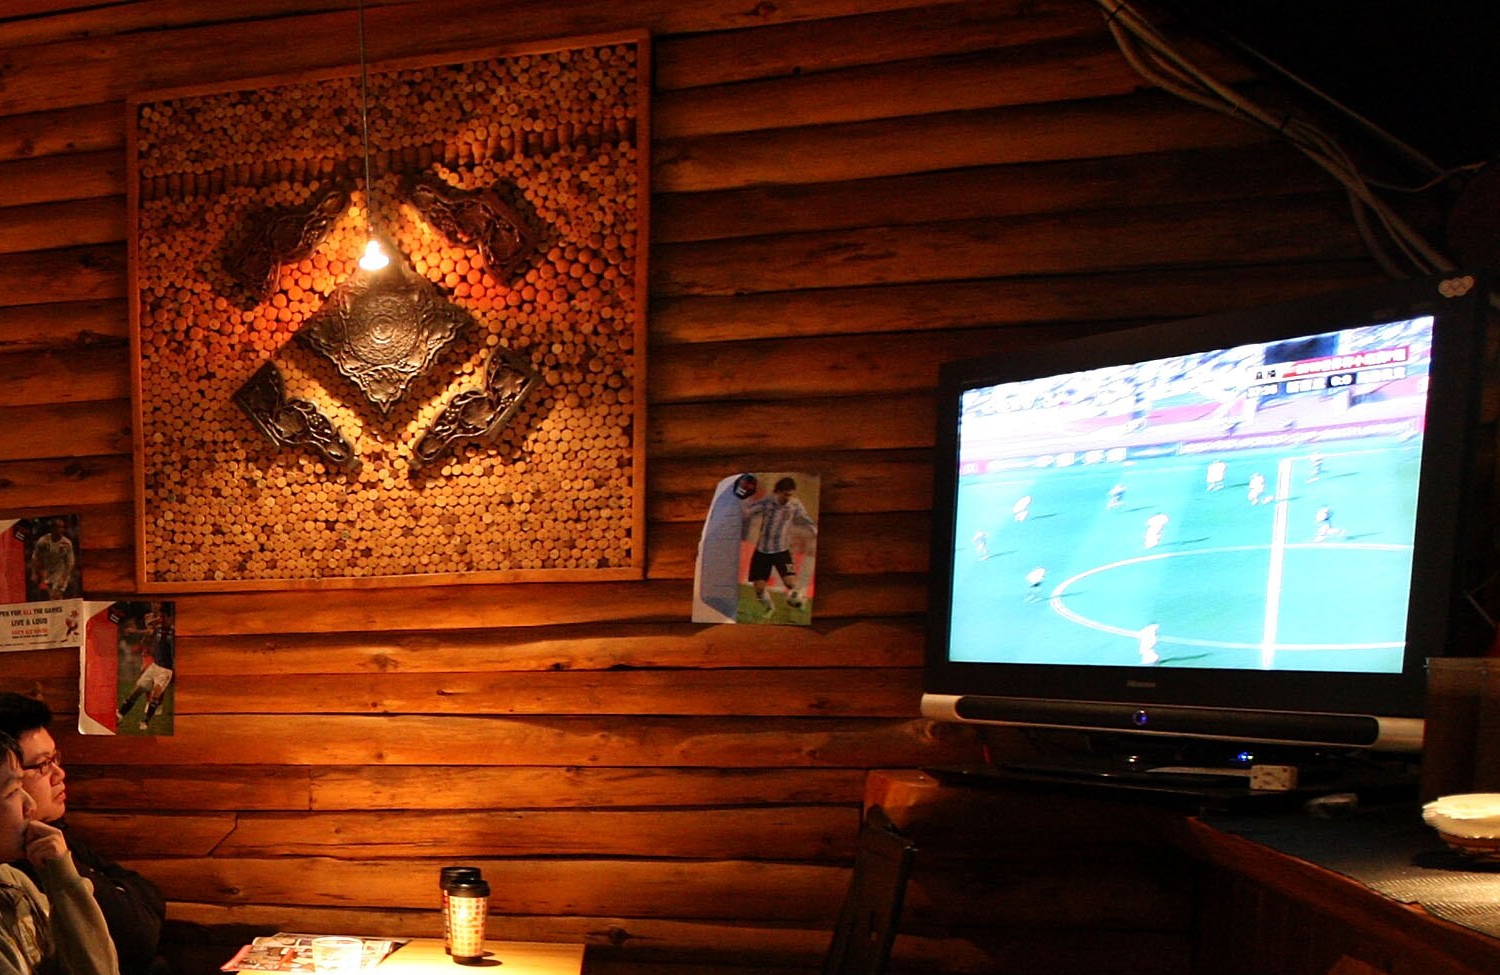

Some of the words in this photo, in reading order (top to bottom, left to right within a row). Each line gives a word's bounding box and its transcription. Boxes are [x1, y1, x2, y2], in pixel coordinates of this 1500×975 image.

[23, 608, 33, 616] ALL
[33, 607, 44, 615] THE
[44, 606, 63, 614] GAMES
[11, 618, 24, 627] LIVE
[32, 617, 48, 625] LOUD
